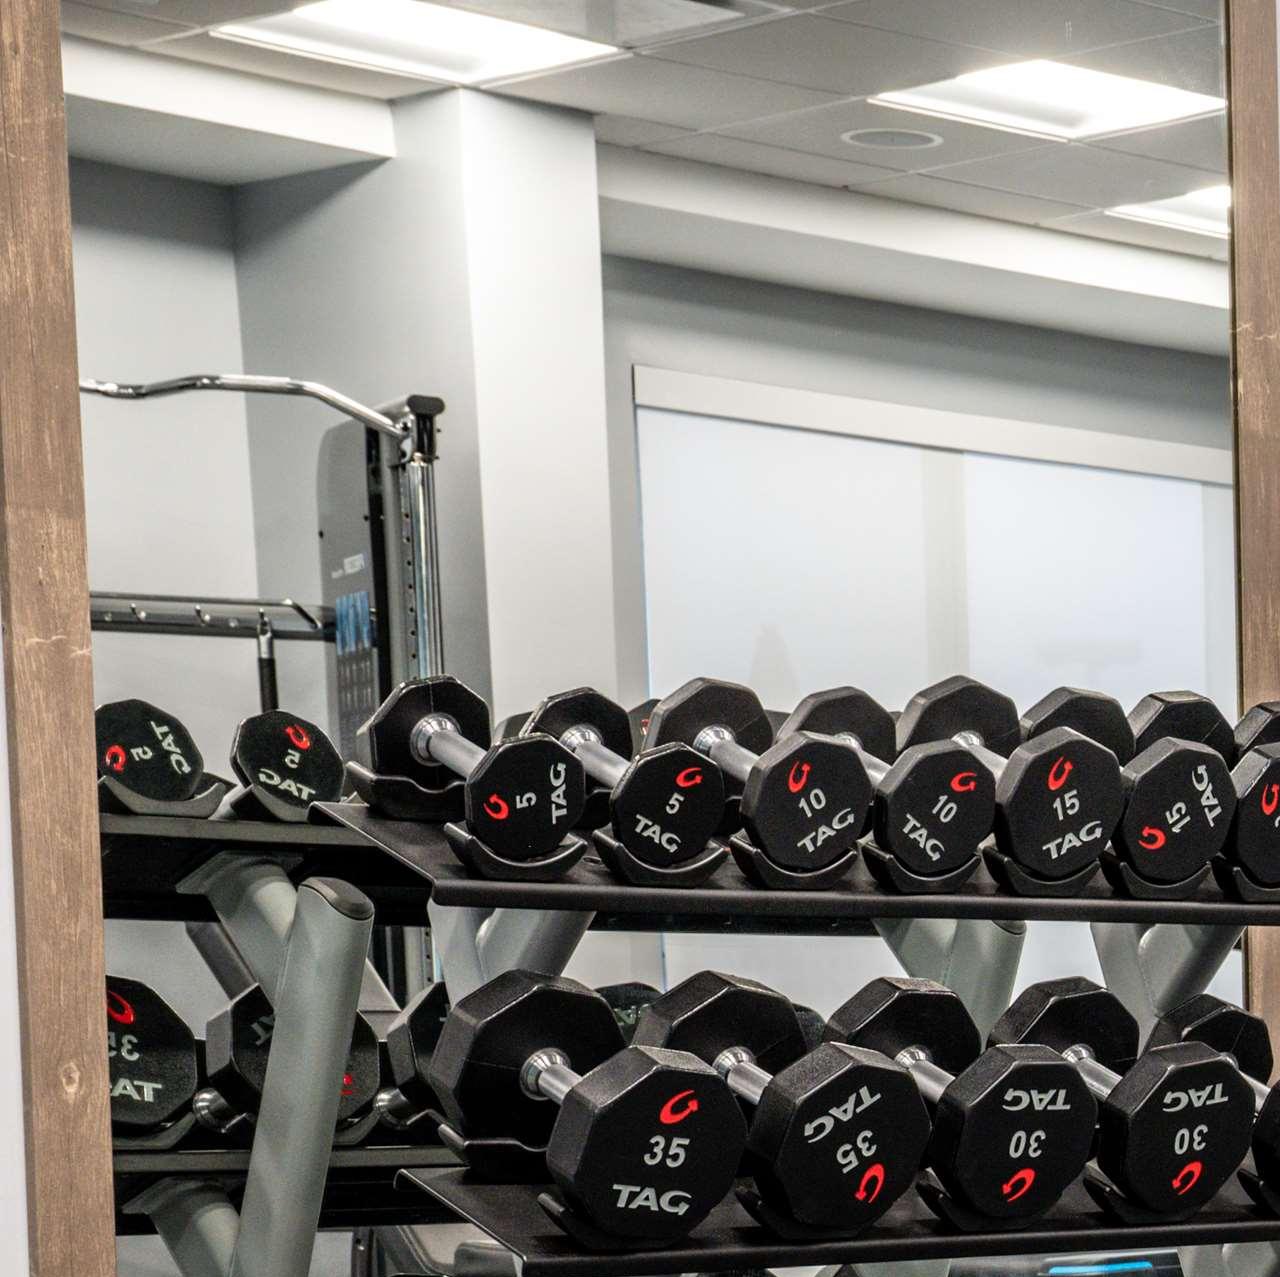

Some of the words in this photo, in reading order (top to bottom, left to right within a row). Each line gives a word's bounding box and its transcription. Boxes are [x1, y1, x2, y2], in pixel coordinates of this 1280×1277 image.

[516, 792, 536, 808] 5
[550, 763, 567, 824] TAG
[666, 793, 684, 814] 5
[799, 789, 825, 817] 10
[932, 795, 957, 823] 10
[1053, 790, 1079, 820] 15
[1192, 765, 1221, 827] TAG
[796, 807, 855, 854] TAG
[1166, 802, 1190, 833] 15
[633, 814, 682, 854] TAG
[902, 814, 946, 862] TAG
[1043, 821, 1102, 859] TAG
[1003, 1089, 1070, 1111] TAG
[1162, 1082, 1229, 1113] TAG
[803, 1085, 882, 1144] TAG
[644, 1136, 690, 1167] 35
[837, 1130, 876, 1173] 35
[1009, 1131, 1045, 1158] 30
[1175, 1125, 1208, 1154] 30
[613, 1184, 691, 1215] TAG
